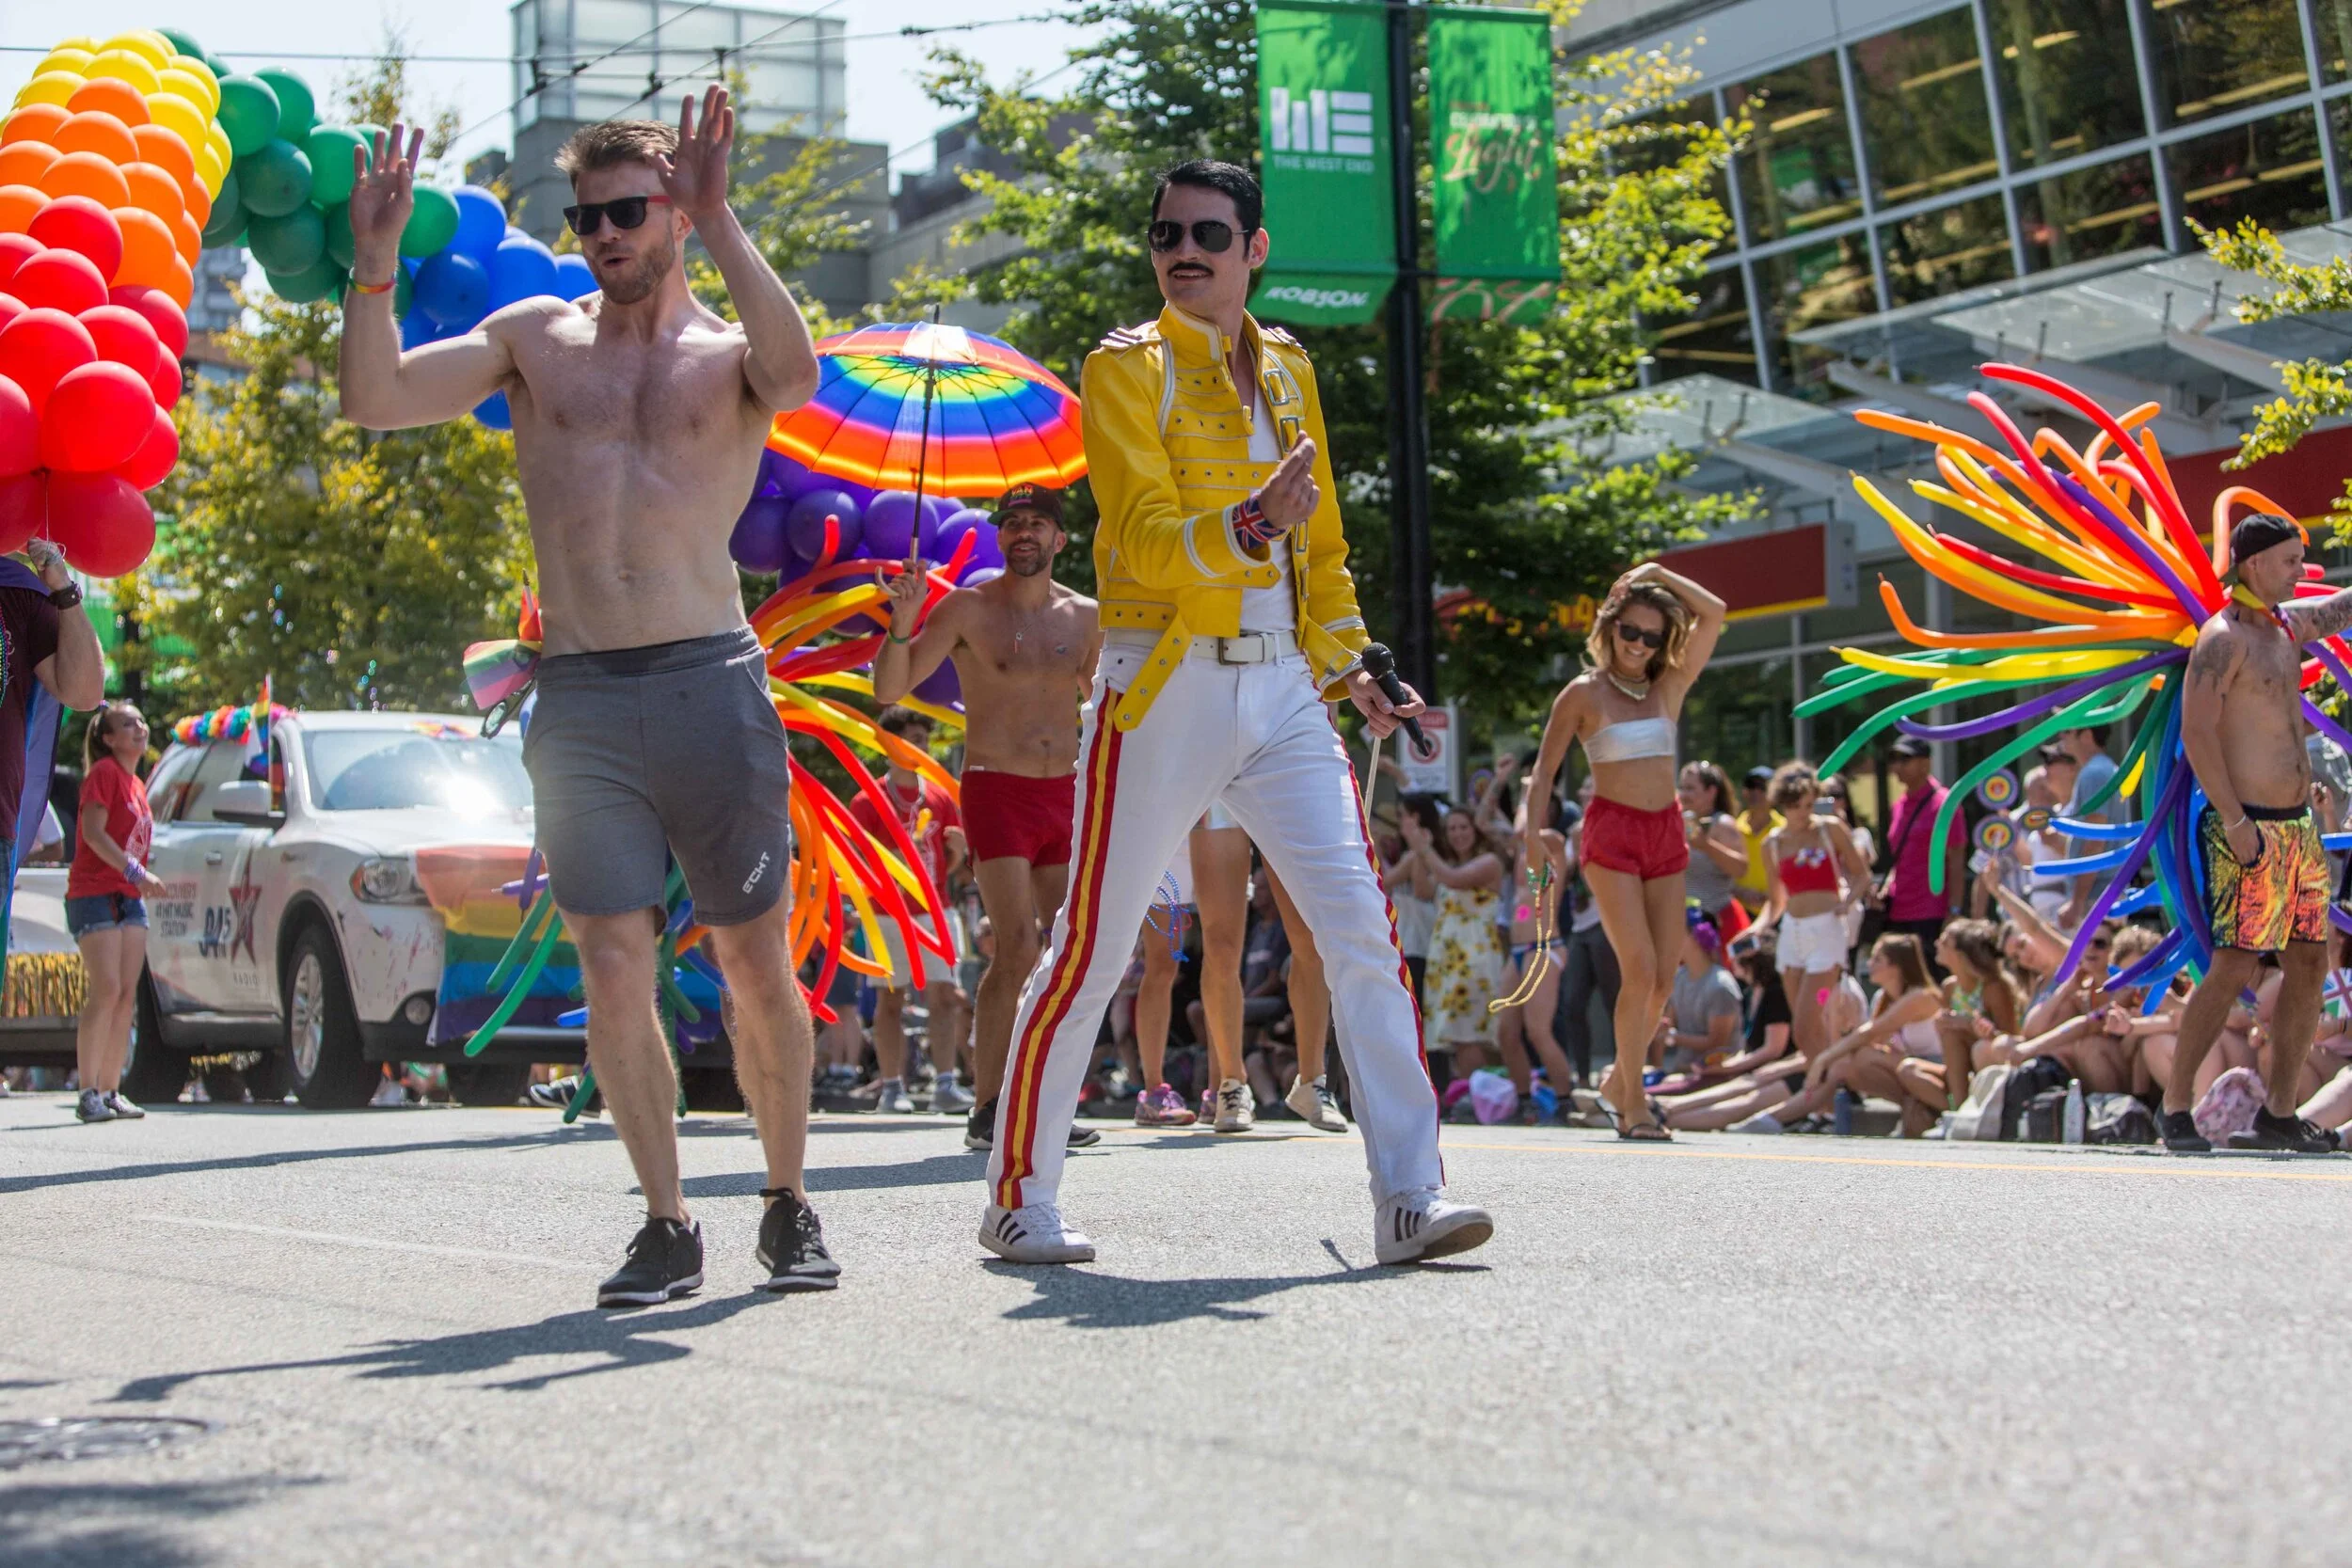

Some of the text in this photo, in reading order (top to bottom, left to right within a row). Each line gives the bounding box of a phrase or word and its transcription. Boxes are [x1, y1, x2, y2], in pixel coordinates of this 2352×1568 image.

[1272, 154, 1375, 175] THE WEST END
[1263, 286, 1370, 309] ROBSON
[742, 851, 771, 895] ECHT
[232, 971, 259, 987] RADIO
